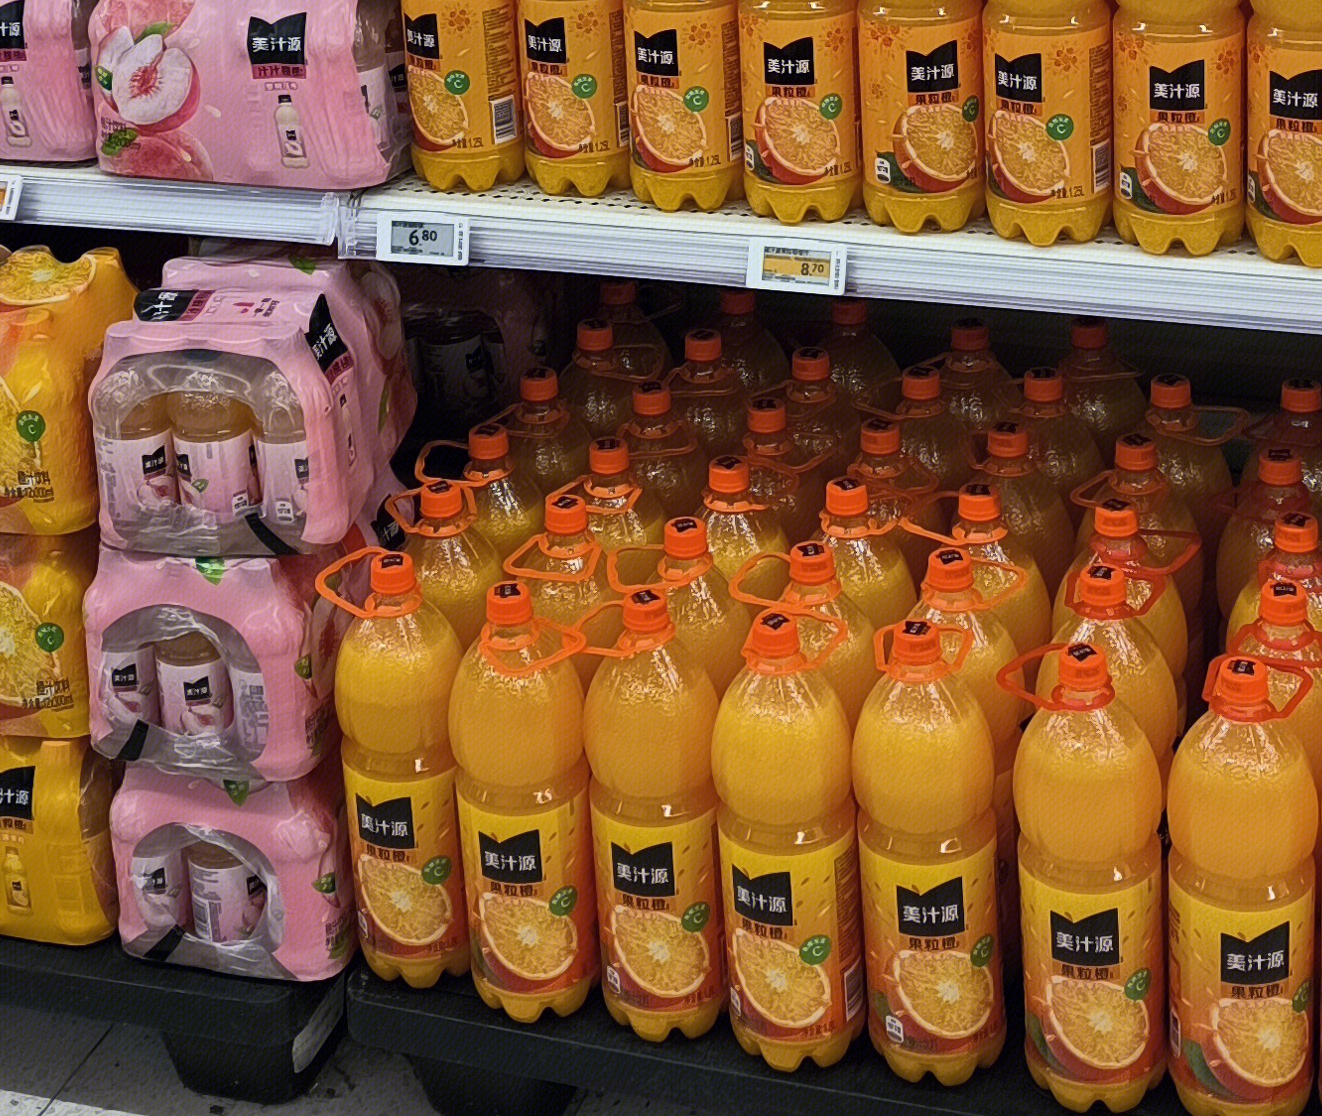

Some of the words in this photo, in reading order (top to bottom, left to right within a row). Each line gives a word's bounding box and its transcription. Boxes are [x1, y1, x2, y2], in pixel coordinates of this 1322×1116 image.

[251, 34, 303, 54] 美汁源
[526, 34, 563, 53] 美汁源
[637, 46, 676, 66] 美汁源
[767, 57, 810, 75] 美汁源
[910, 62, 955, 81] 美汁源
[997, 70, 1038, 92] 美汁源
[1153, 81, 1200, 100] 美汁源
[1272, 88, 1319, 109] 美汁源
[408, 229, 438, 246] 6.80
[800, 262, 825, 276] 8.70
[361, 812, 409, 840] 美汁源
[483, 848, 538, 872] 美汁源
[616, 861, 670, 886] 美汁源
[736, 884, 788, 915] 美汁源
[902, 902, 960, 925] 美汁源
[1055, 930, 1115, 955] 美汁源
[1226, 949, 1286, 972] 美汁源
